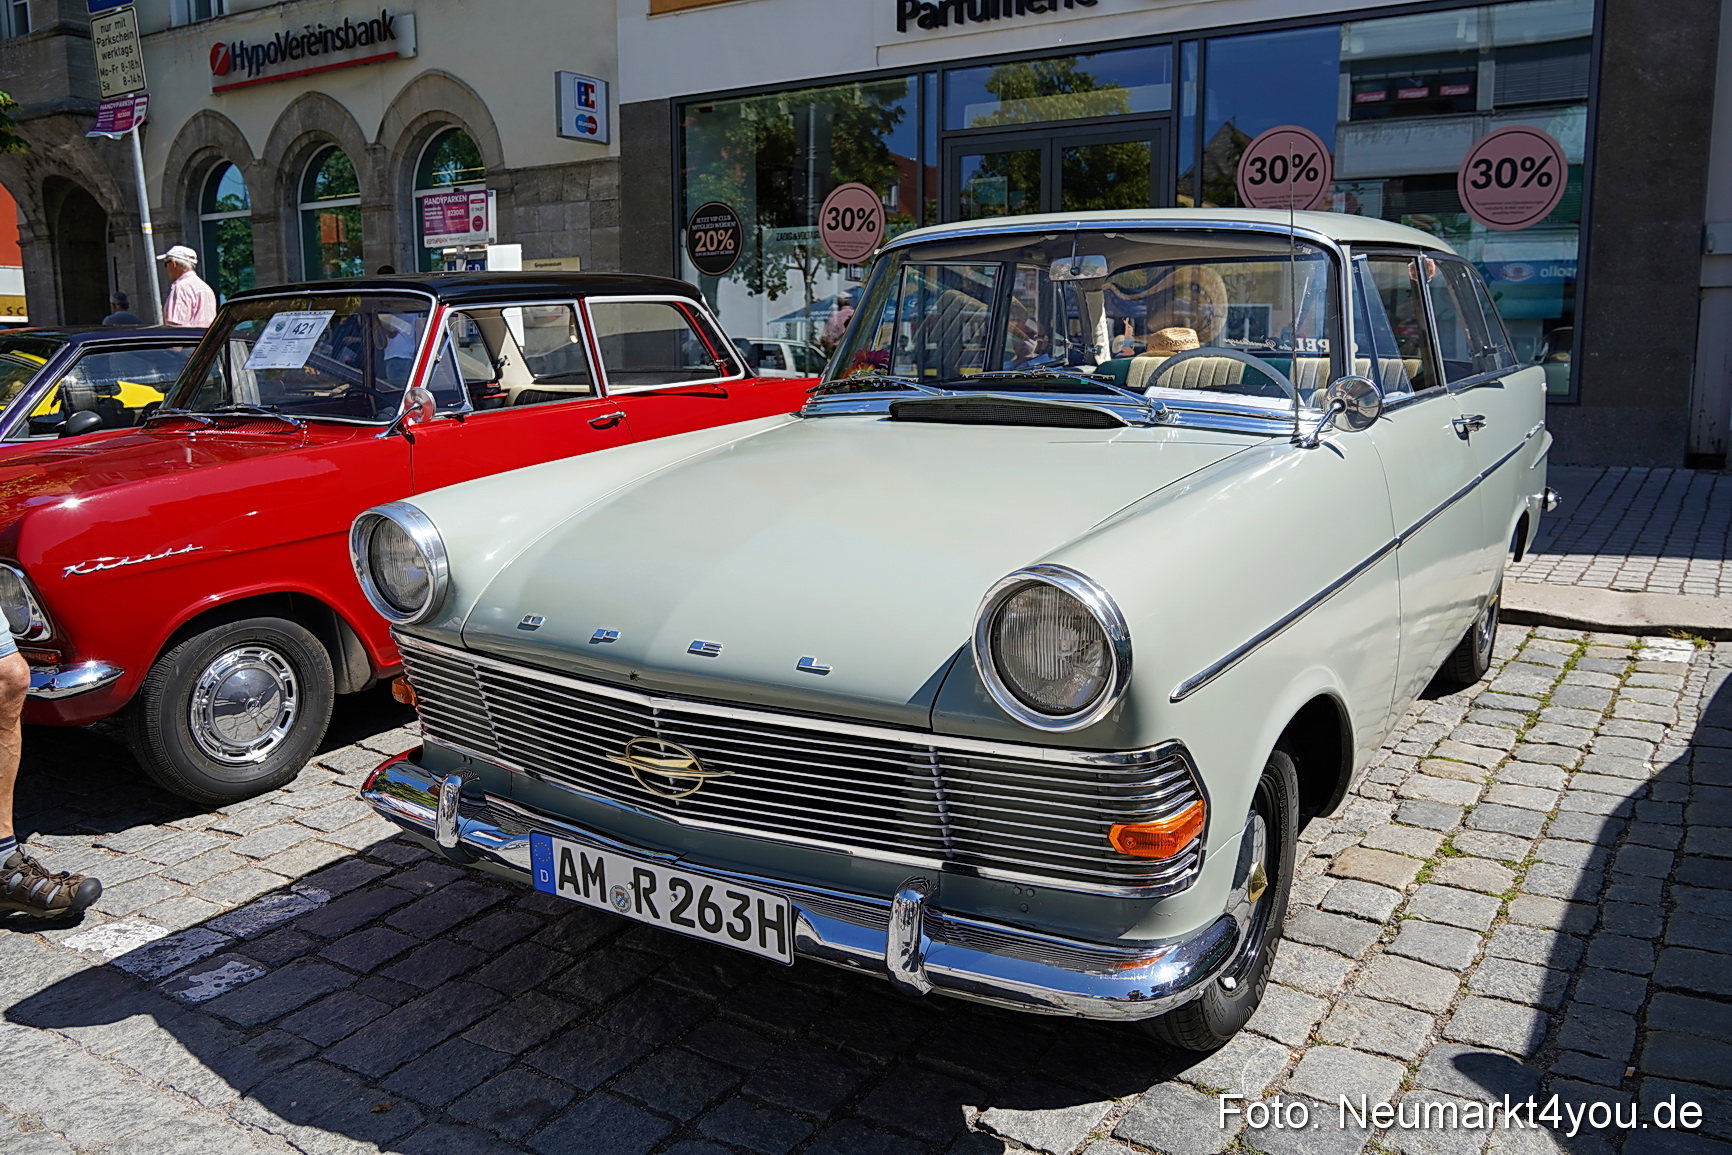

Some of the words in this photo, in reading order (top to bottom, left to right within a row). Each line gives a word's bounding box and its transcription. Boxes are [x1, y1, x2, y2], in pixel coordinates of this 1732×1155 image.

[100, 22, 111, 33] nur
[115, 17, 127, 30] mit
[96, 29, 134, 48] Parkschein
[231, 9, 396, 78] HypoVereinsbank
[101, 44, 134, 60] werktags
[100, 64, 119, 78] Mo-Fr
[102, 81, 110, 91] Sa
[100, 99, 134, 111] HANDYPARKEN
[1248, 152, 1319, 186] 30%
[1470, 155, 1554, 190] 30%
[424, 194, 467, 206] HANDYPARKEN
[691, 222, 714, 231] MITGLIED
[696, 216, 710, 224] JETZT
[826, 206, 877, 233] 30%
[695, 228, 735, 252] 20%
[0, 305, 25, 316] SC
[292, 322, 316, 335] 421
[62, 543, 203, 579] Kadett
[517, 612, 833, 676] OPEL
[540, 869, 549, 883] D
[558, 846, 607, 904] AM
[633, 866, 660, 919] R
[668, 877, 787, 955] 263H
